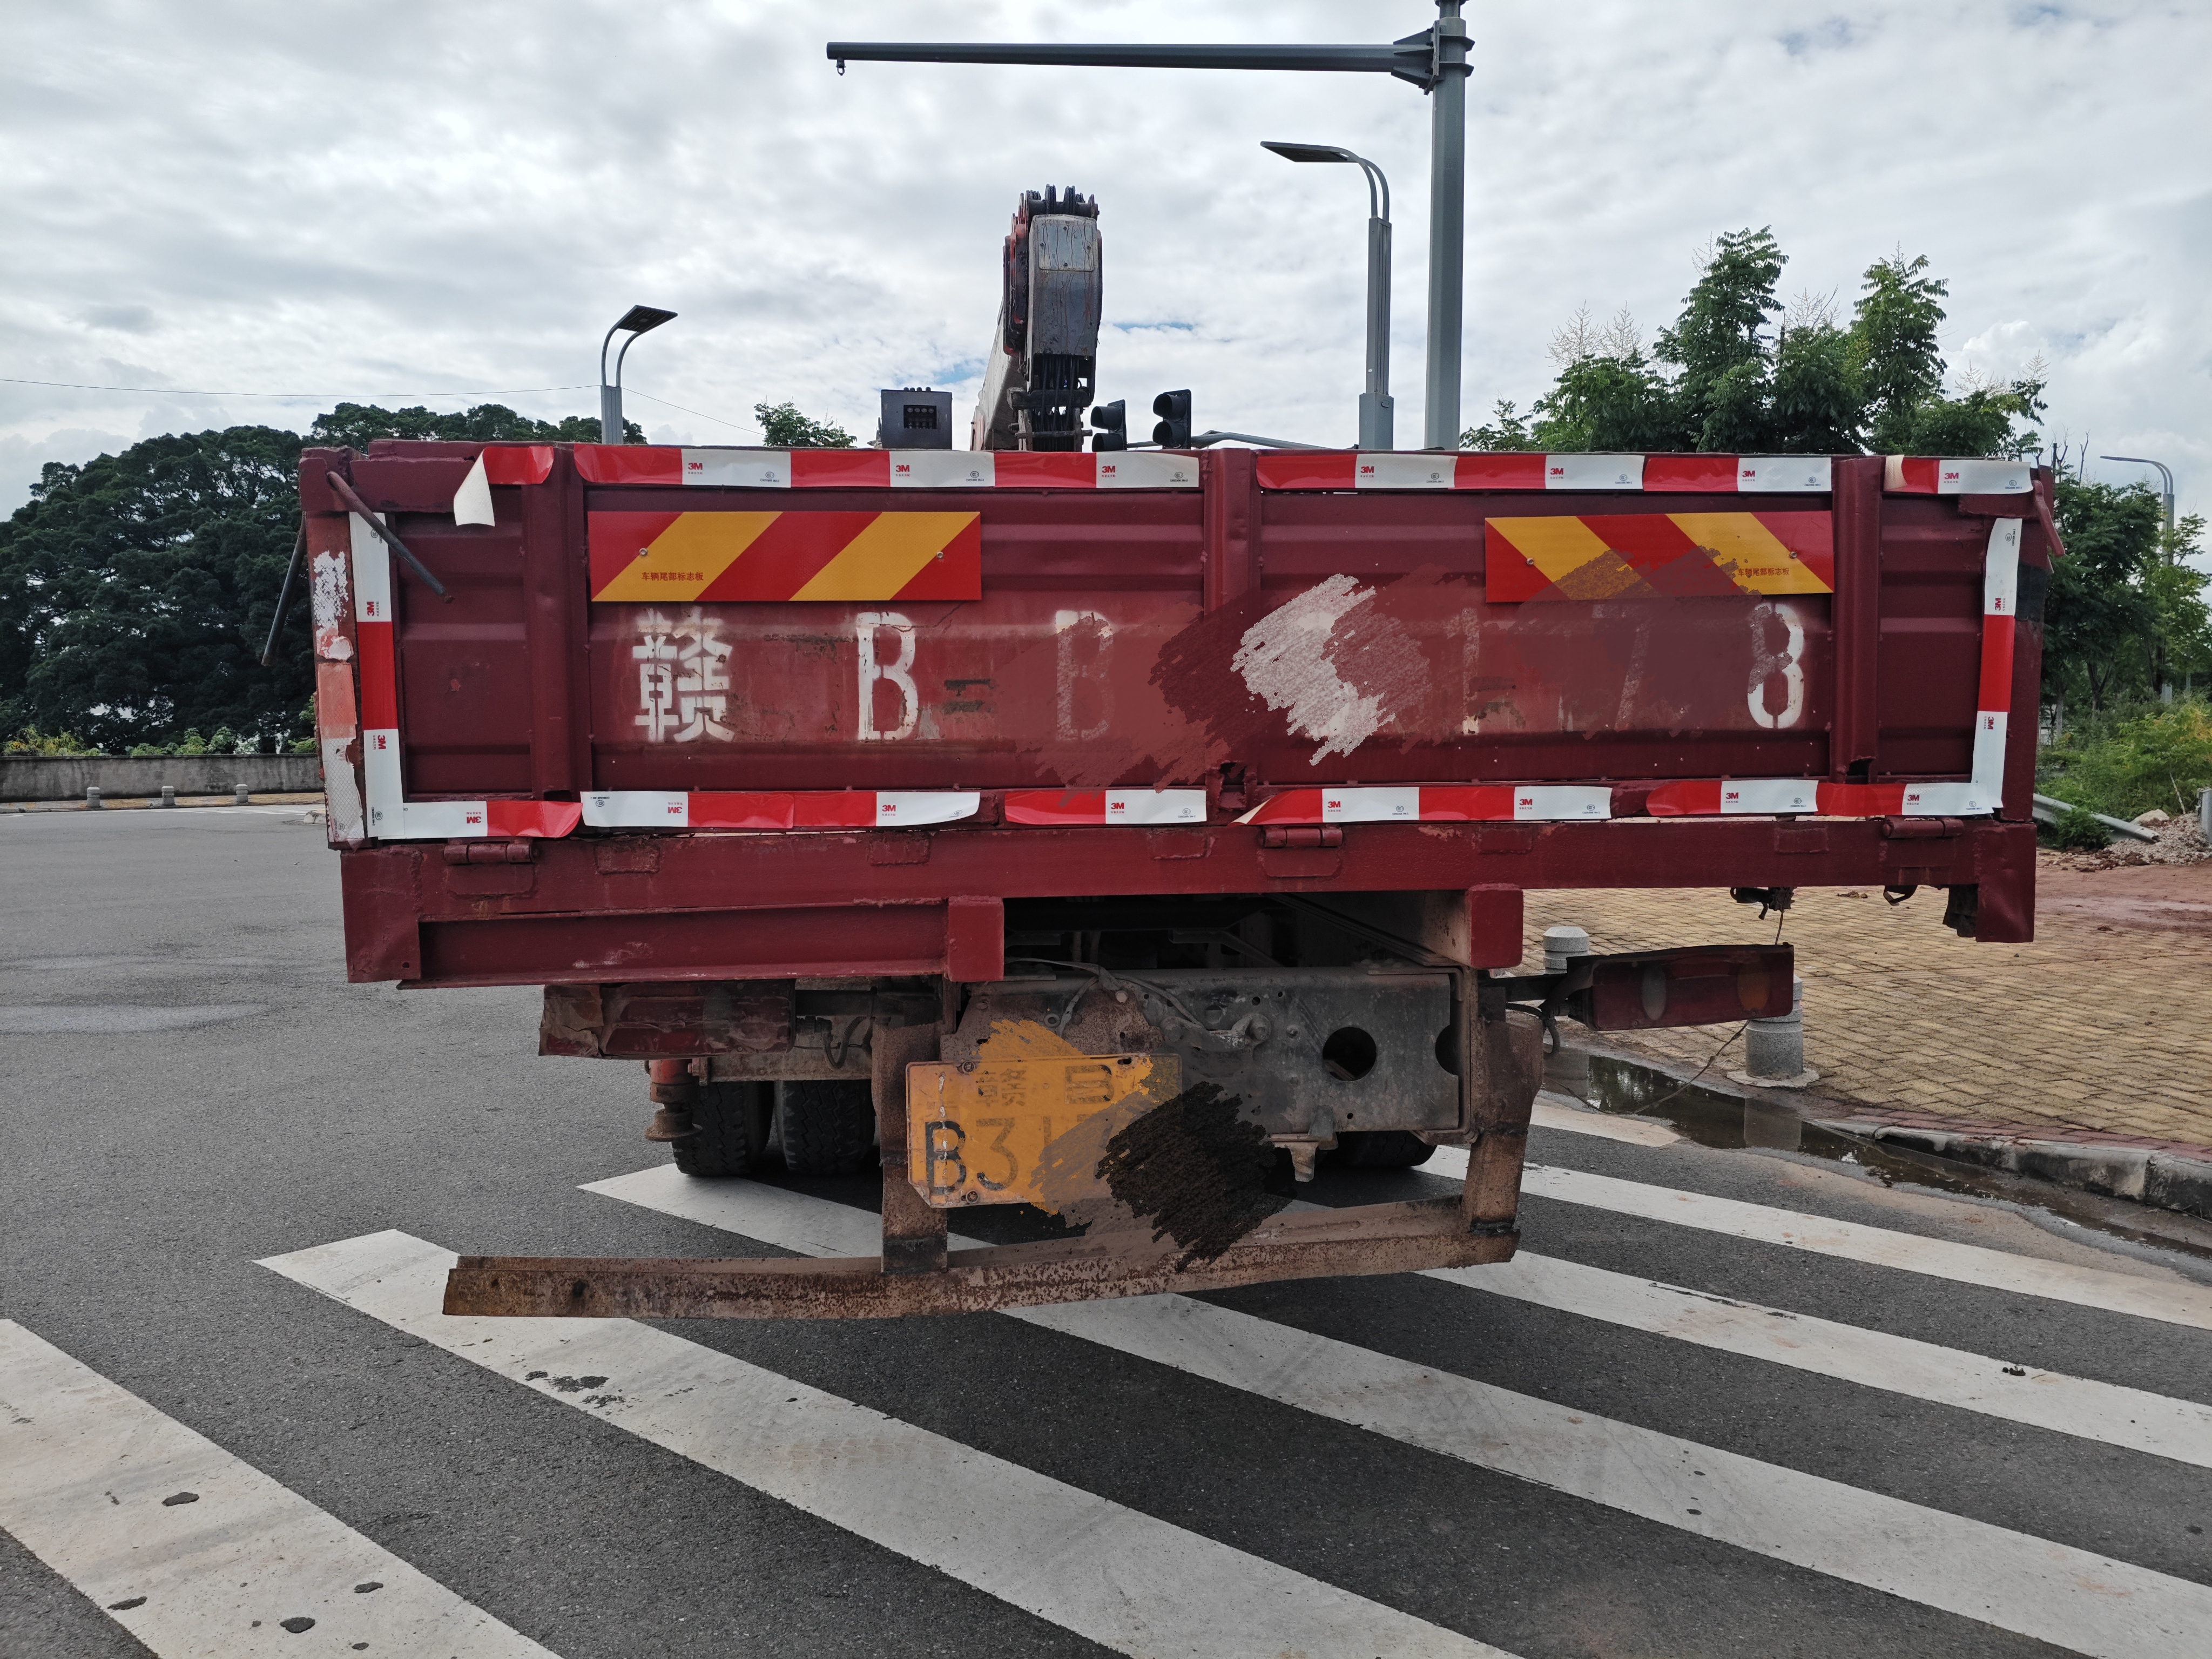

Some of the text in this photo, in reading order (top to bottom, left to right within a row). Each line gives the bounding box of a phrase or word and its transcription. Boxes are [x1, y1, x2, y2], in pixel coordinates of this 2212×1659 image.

[687, 462, 703, 470] 3M
[895, 464, 910, 473] 3M
[1102, 466, 1116, 474] 3M
[1360, 466, 1374, 474] 3M
[1742, 470, 1756, 478] 3M
[641, 571, 704, 581] 车辆尾部标志板
[1737, 567, 1790, 577] 车辆尾部标志板
[1994, 597, 2002, 612] 3M
[366, 601, 375, 617] 3M
[1987, 716, 1994, 730] 3M
[377, 734, 386, 750] 3M
[1725, 792, 1739, 800] 3M
[882, 804, 896, 812] 3M
[1327, 800, 1341, 808] 3M
[466, 816, 482, 824] 3M
